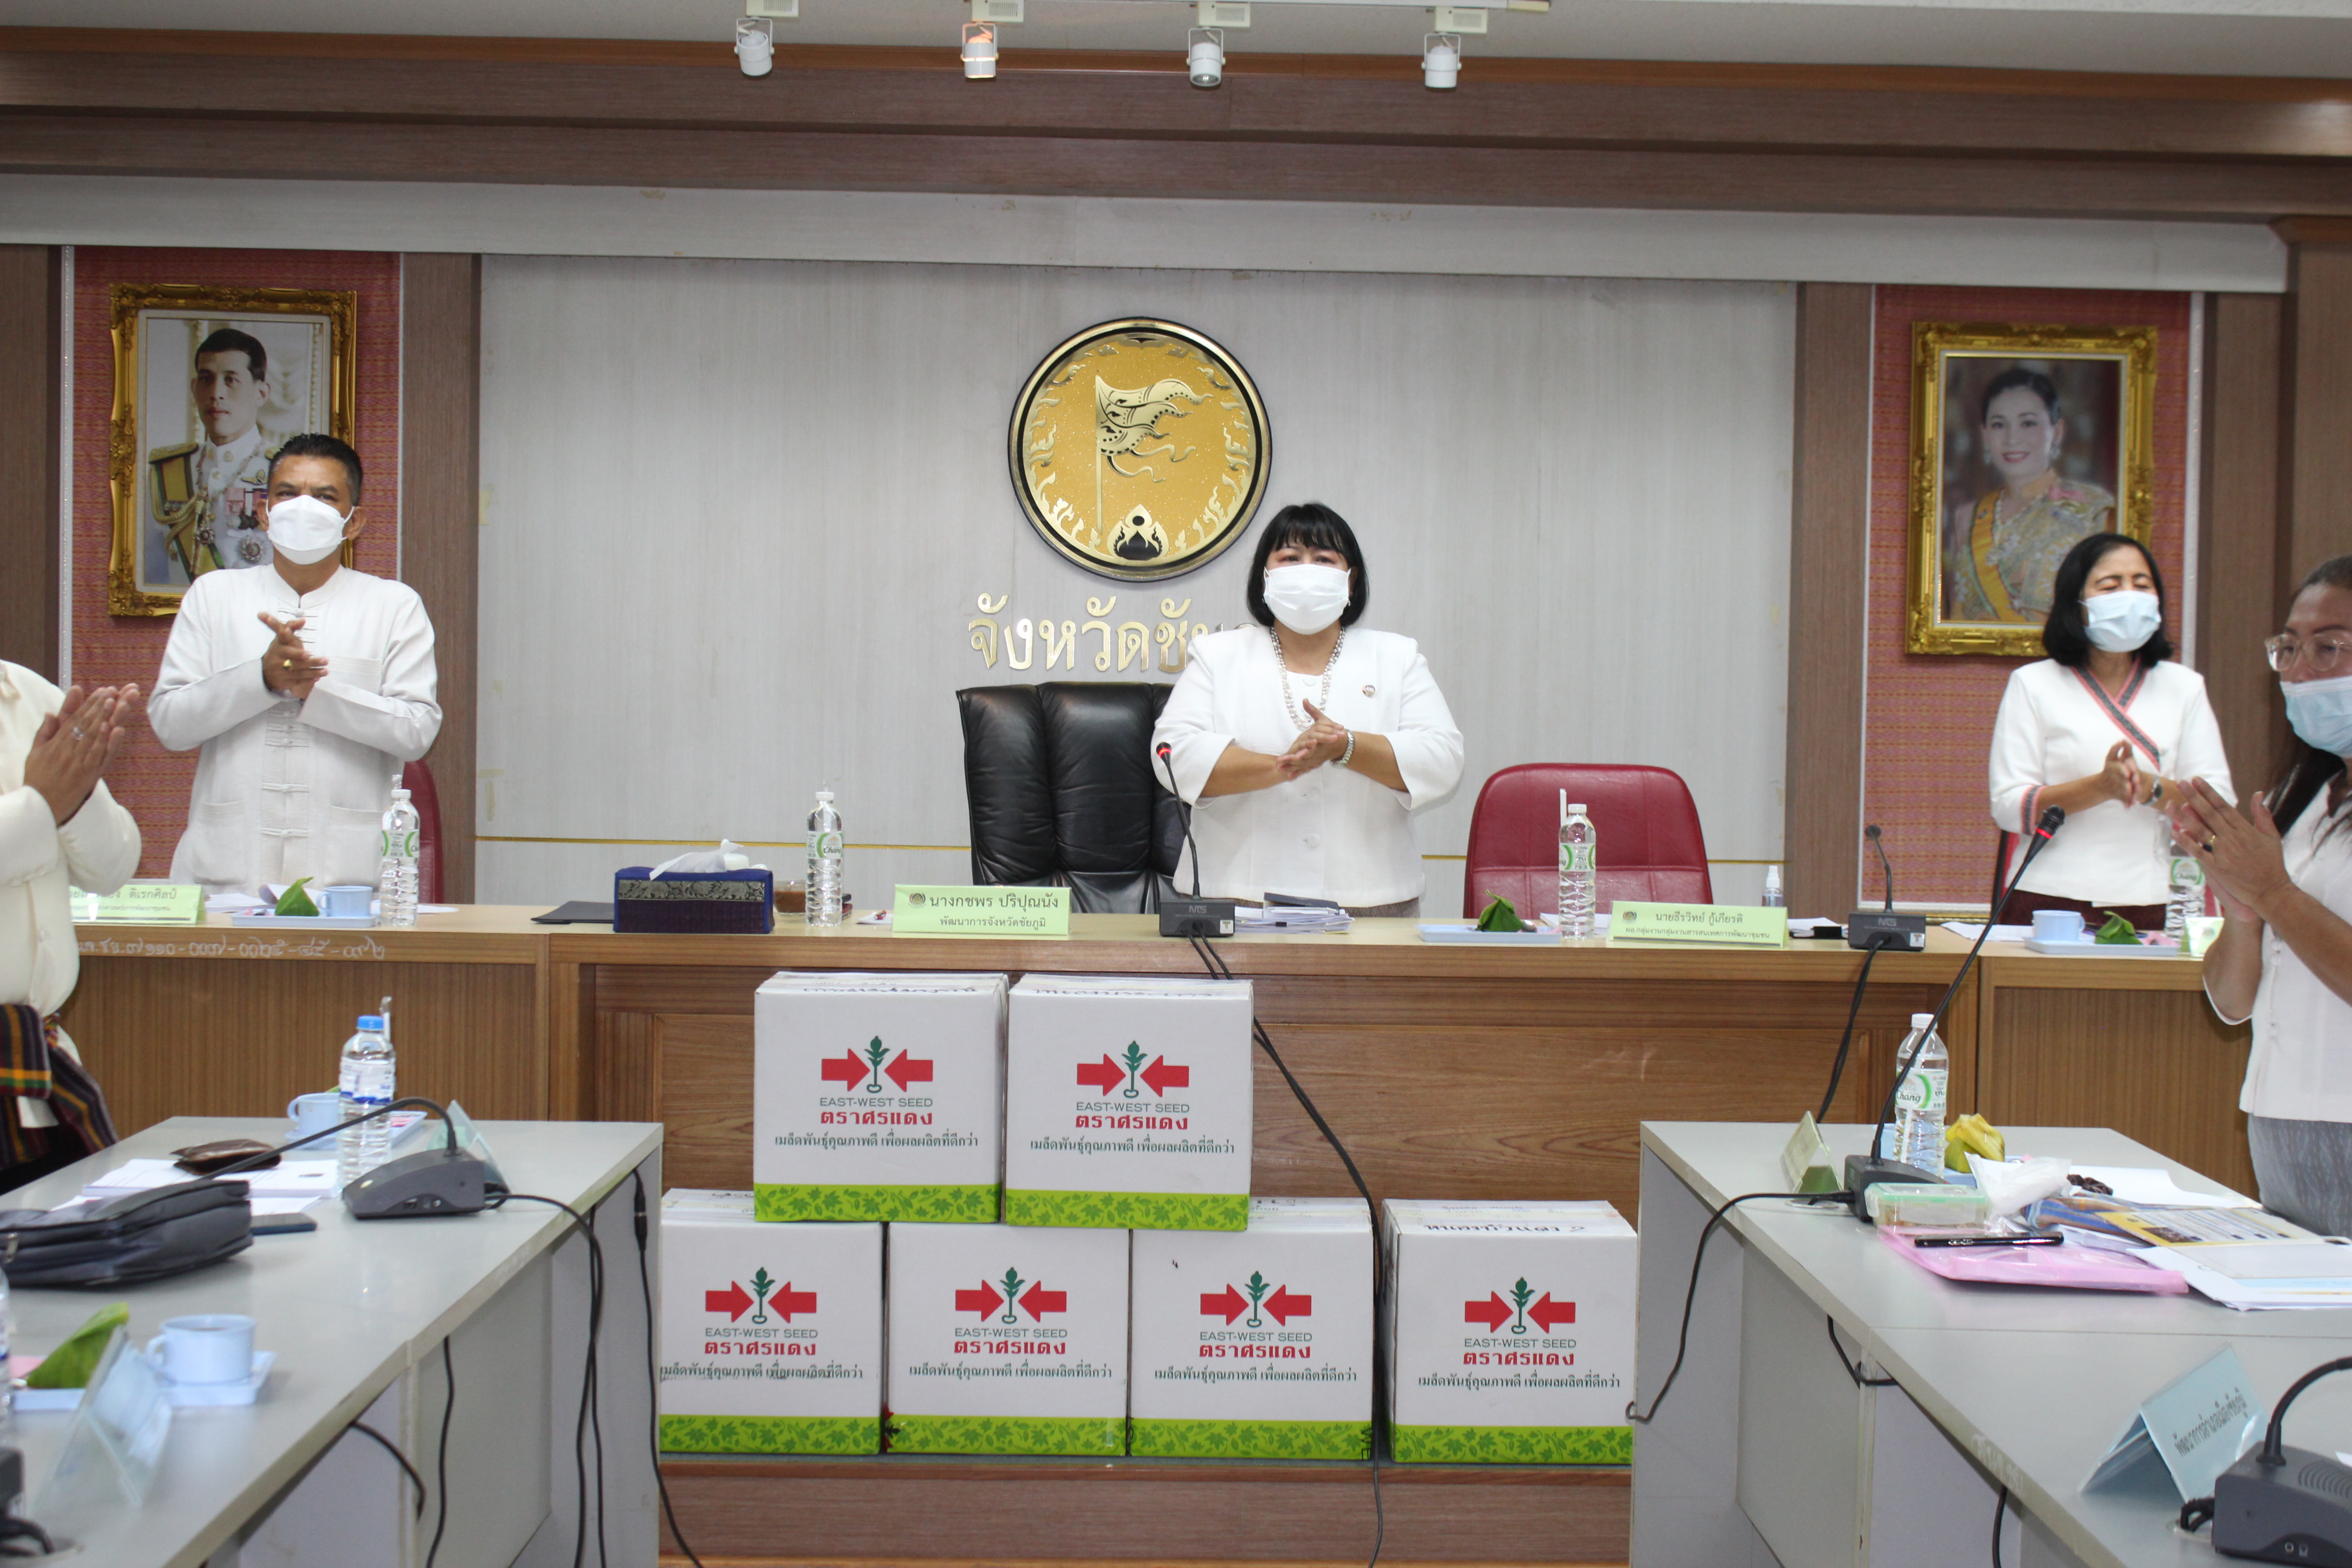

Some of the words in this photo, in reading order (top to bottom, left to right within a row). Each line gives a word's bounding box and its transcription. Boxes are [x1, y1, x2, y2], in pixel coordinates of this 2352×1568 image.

[968, 593, 1258, 673] จังหวัดชั
[930, 897, 993, 908] นางกชพร
[999, 892, 1058, 912] ปริปุณนัง
[940, 916, 1046, 930] พัฒนาการจังหวัดชัยภูมิ
[1656, 911, 1705, 923] นายธีรวิทย์
[820, 1098, 894, 1107] EAST-WEST
[899, 1098, 933, 1107] SEED
[1896, 1091, 1921, 1103] Chang
[1077, 1102, 1151, 1112] EAST-WEST
[1156, 1103, 1190, 1113] SEED
[821, 1111, 932, 1125] ตราศรแดง
[1075, 1115, 1188, 1130] ตราศรแดง
[775, 1131, 877, 1150] เมล็ดพันธุ์คุณภาพดี
[882, 1128, 978, 1147] เพื่อผลผลิตที่ดีกว่า
[1031, 1136, 1133, 1155] เมล็ดพันธุ์คุณภาพดี
[1137, 1134, 1234, 1153] เพื่อผลผลิตที่ดีกว่า
[706, 1328, 779, 1338] EAST-WEST
[784, 1329, 818, 1338] SEED
[955, 1328, 1029, 1338] EAST-WEST
[1034, 1329, 1067, 1338] SEED
[1200, 1332, 1274, 1342] EAST-WEST
[1279, 1333, 1312, 1342] SEED
[705, 1341, 816, 1356] ตราศรแดง
[954, 1340, 1065, 1354] ตราศรแดง
[1465, 1338, 1539, 1348] EAST-WEST
[1543, 1339, 1576, 1348] SEED
[1199, 1344, 1310, 1358] ตราศรแดง
[1463, 1351, 1574, 1366] ตราศรแดง
[660, 1362, 762, 1380] เมล็ดพันธุ์คุณภาพดี
[766, 1359, 862, 1378] เพื่อผลผลิตที่ดีกว่า
[910, 1361, 1012, 1380] เมล็ดพันธุ์คุณภาพดี
[1016, 1359, 1112, 1377] เพื่อผลผลิตที่ดีกว่า
[1155, 1365, 1257, 1384] เมล็ดพันธุ์คุณภาพดี
[1261, 1362, 1356, 1382] เพื่อผลผลิตที่ดีกว่า
[1419, 1372, 1521, 1391] เมล็ดพันธุ์คุณภาพดี
[1525, 1369, 1620, 1387] เพื่อผลผลิตที่ดีกว่า
